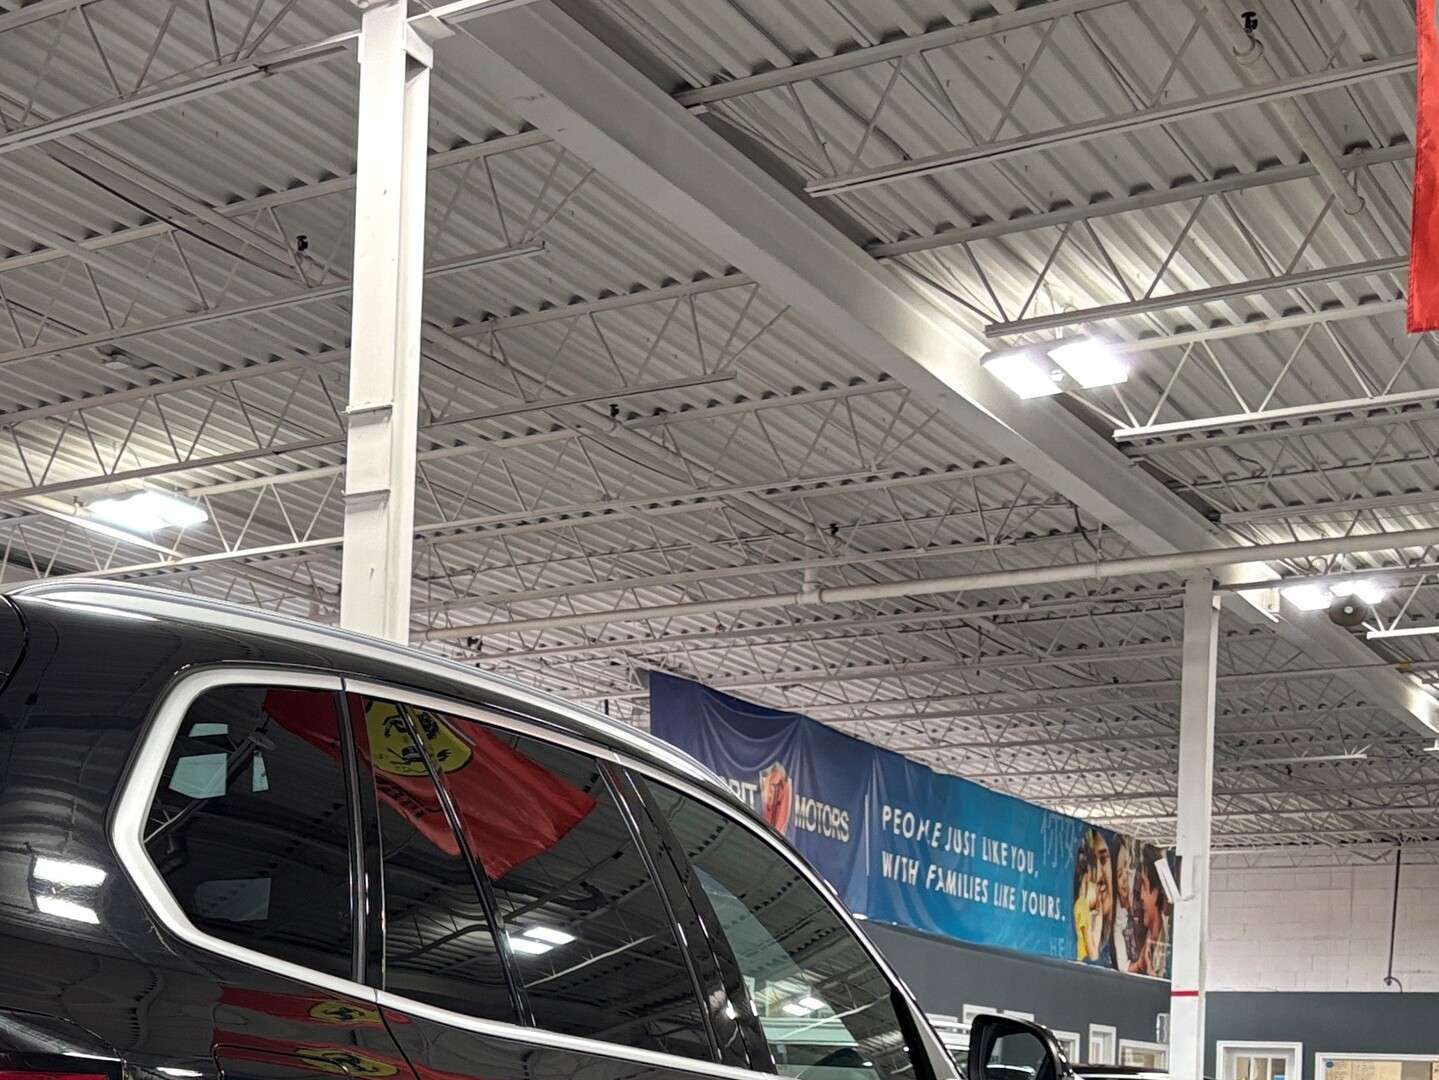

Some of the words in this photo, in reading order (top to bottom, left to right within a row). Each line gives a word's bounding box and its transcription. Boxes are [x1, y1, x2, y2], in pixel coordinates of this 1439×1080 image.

[794, 794, 850, 842] MOTORS
[944, 826, 976, 857] JUST
[982, 837, 1008, 866] LIKE
[1011, 846, 1039, 878] YOU,
[882, 851, 919, 886] WITH
[925, 865, 989, 904] FAMILIES
[993, 882, 1016, 911] LIKE
[1021, 890, 1066, 922] YOURS.
